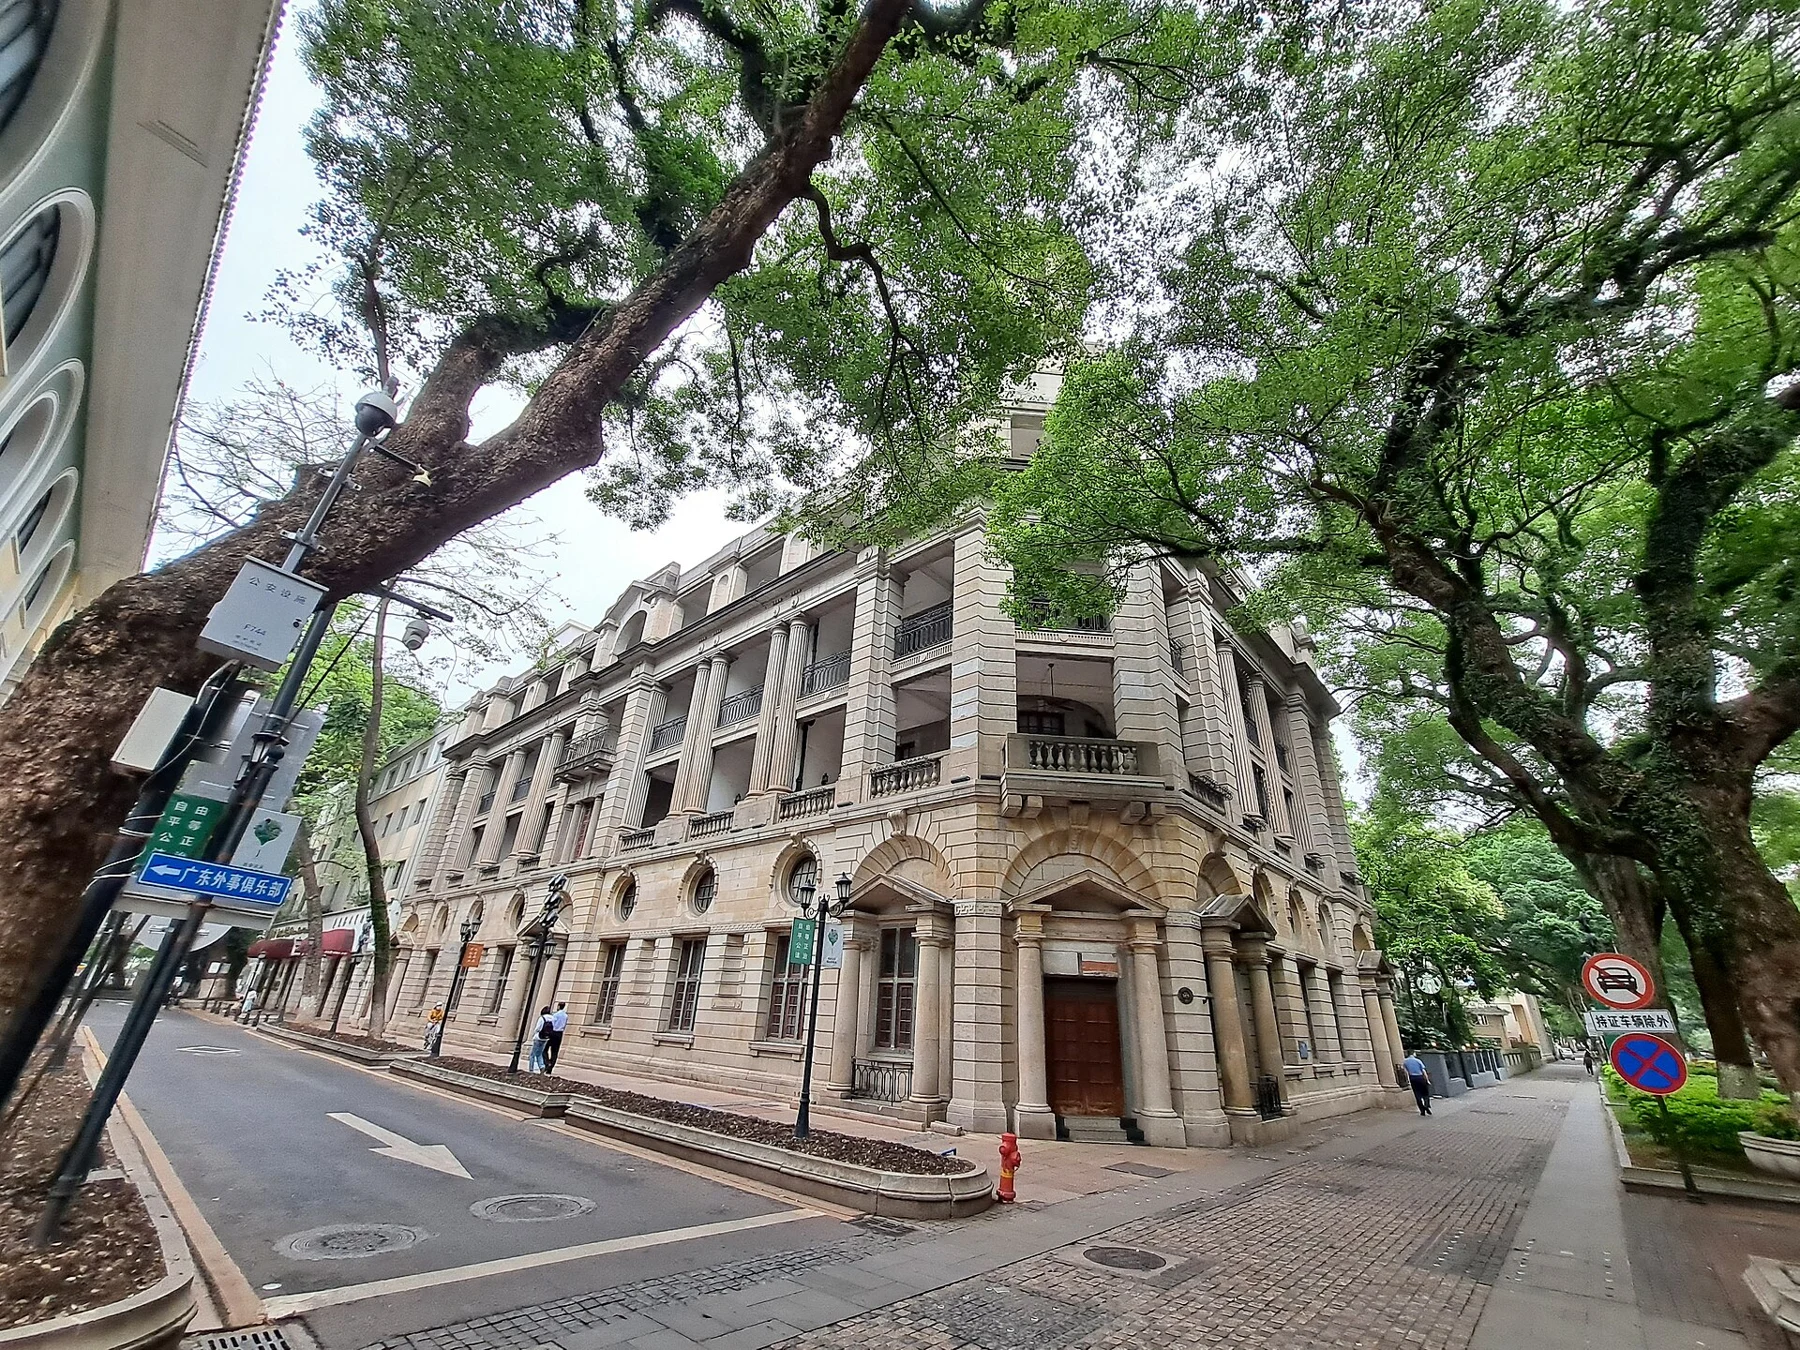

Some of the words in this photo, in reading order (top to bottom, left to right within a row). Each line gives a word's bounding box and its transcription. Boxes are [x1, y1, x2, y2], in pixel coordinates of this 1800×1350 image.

[249, 576, 308, 606] 公安设施
[174, 801, 209, 816] 自由
[167, 815, 203, 831] 平等
[159, 832, 195, 847] 公正
[178, 866, 284, 898] 广东外事俱乐部
[1595, 1015, 1669, 1028] 持证车辆除外
